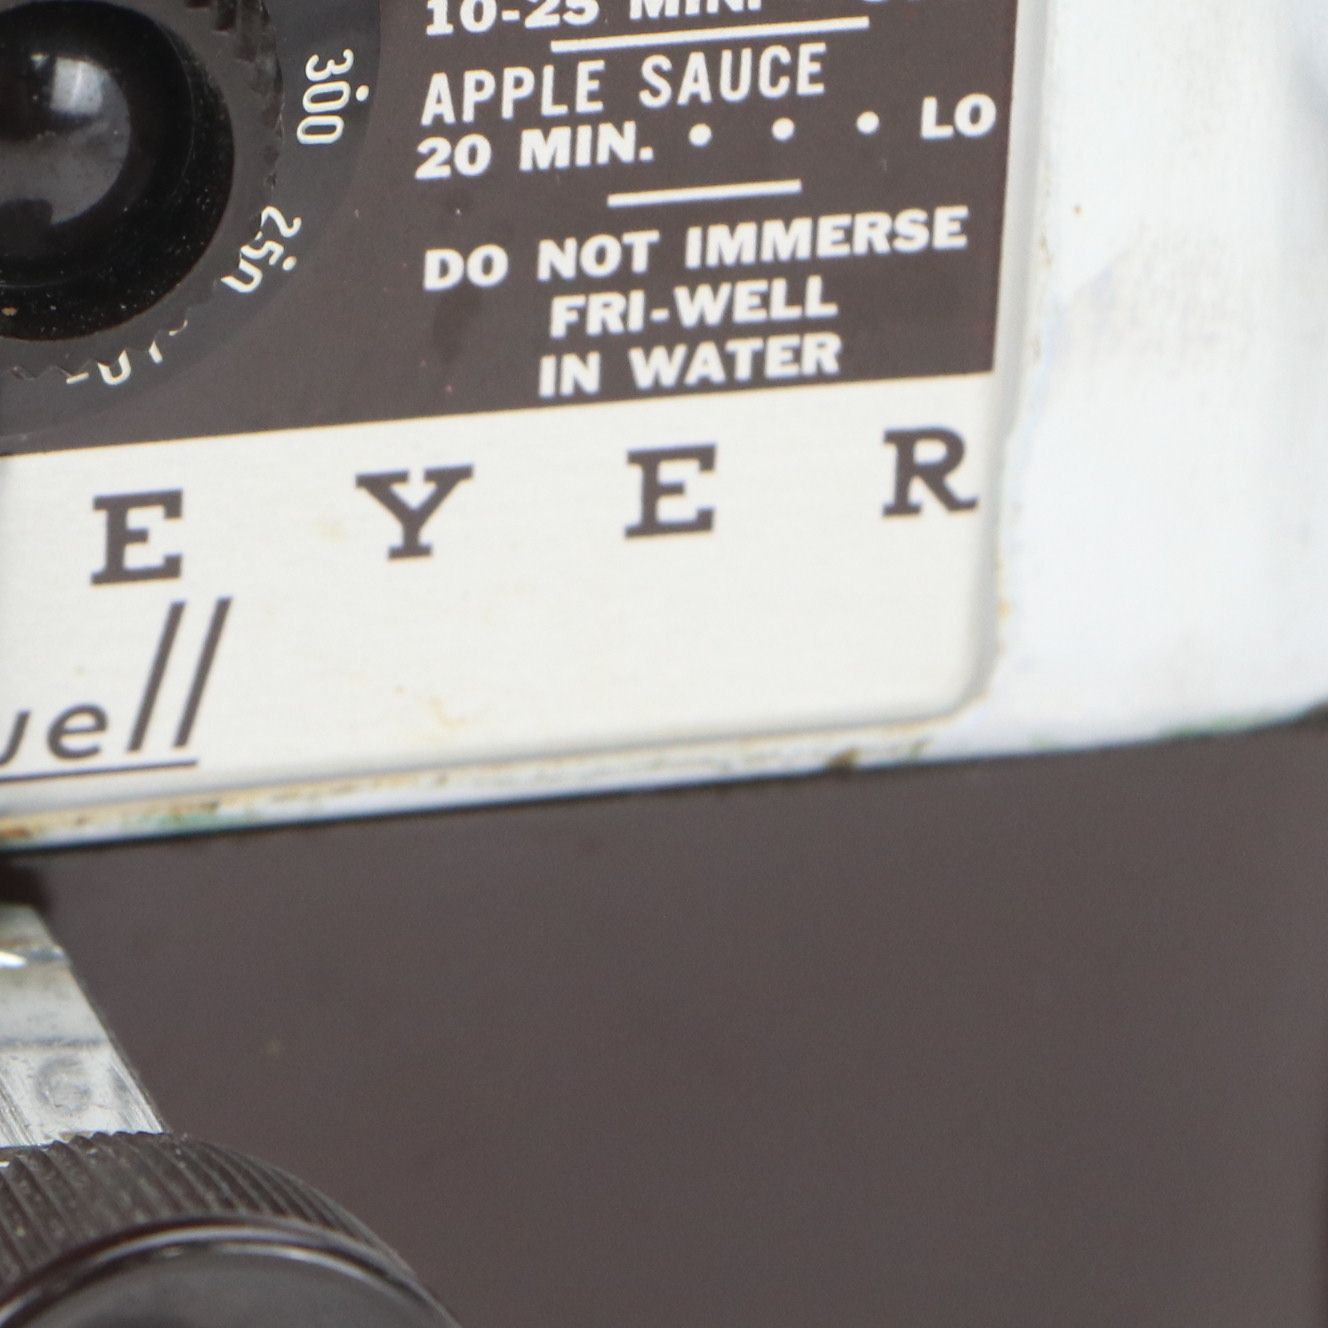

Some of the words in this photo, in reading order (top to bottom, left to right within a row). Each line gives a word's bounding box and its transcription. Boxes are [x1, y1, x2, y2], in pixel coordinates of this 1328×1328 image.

[295, 47, 355, 147] 300
[420, 59, 605, 126] APPLE
[639, 42, 827, 108] SAUCE
[415, 133, 492, 180] 20
[519, 120, 654, 171] MIN.
[921, 93, 997, 139] LO
[423, 244, 508, 291] DO
[537, 230, 660, 281] NOT
[685, 205, 969, 269] IMMERSE
[550, 275, 838, 338] FRI-WELL
[539, 352, 600, 397] IN
[629, 332, 842, 389] WATER
